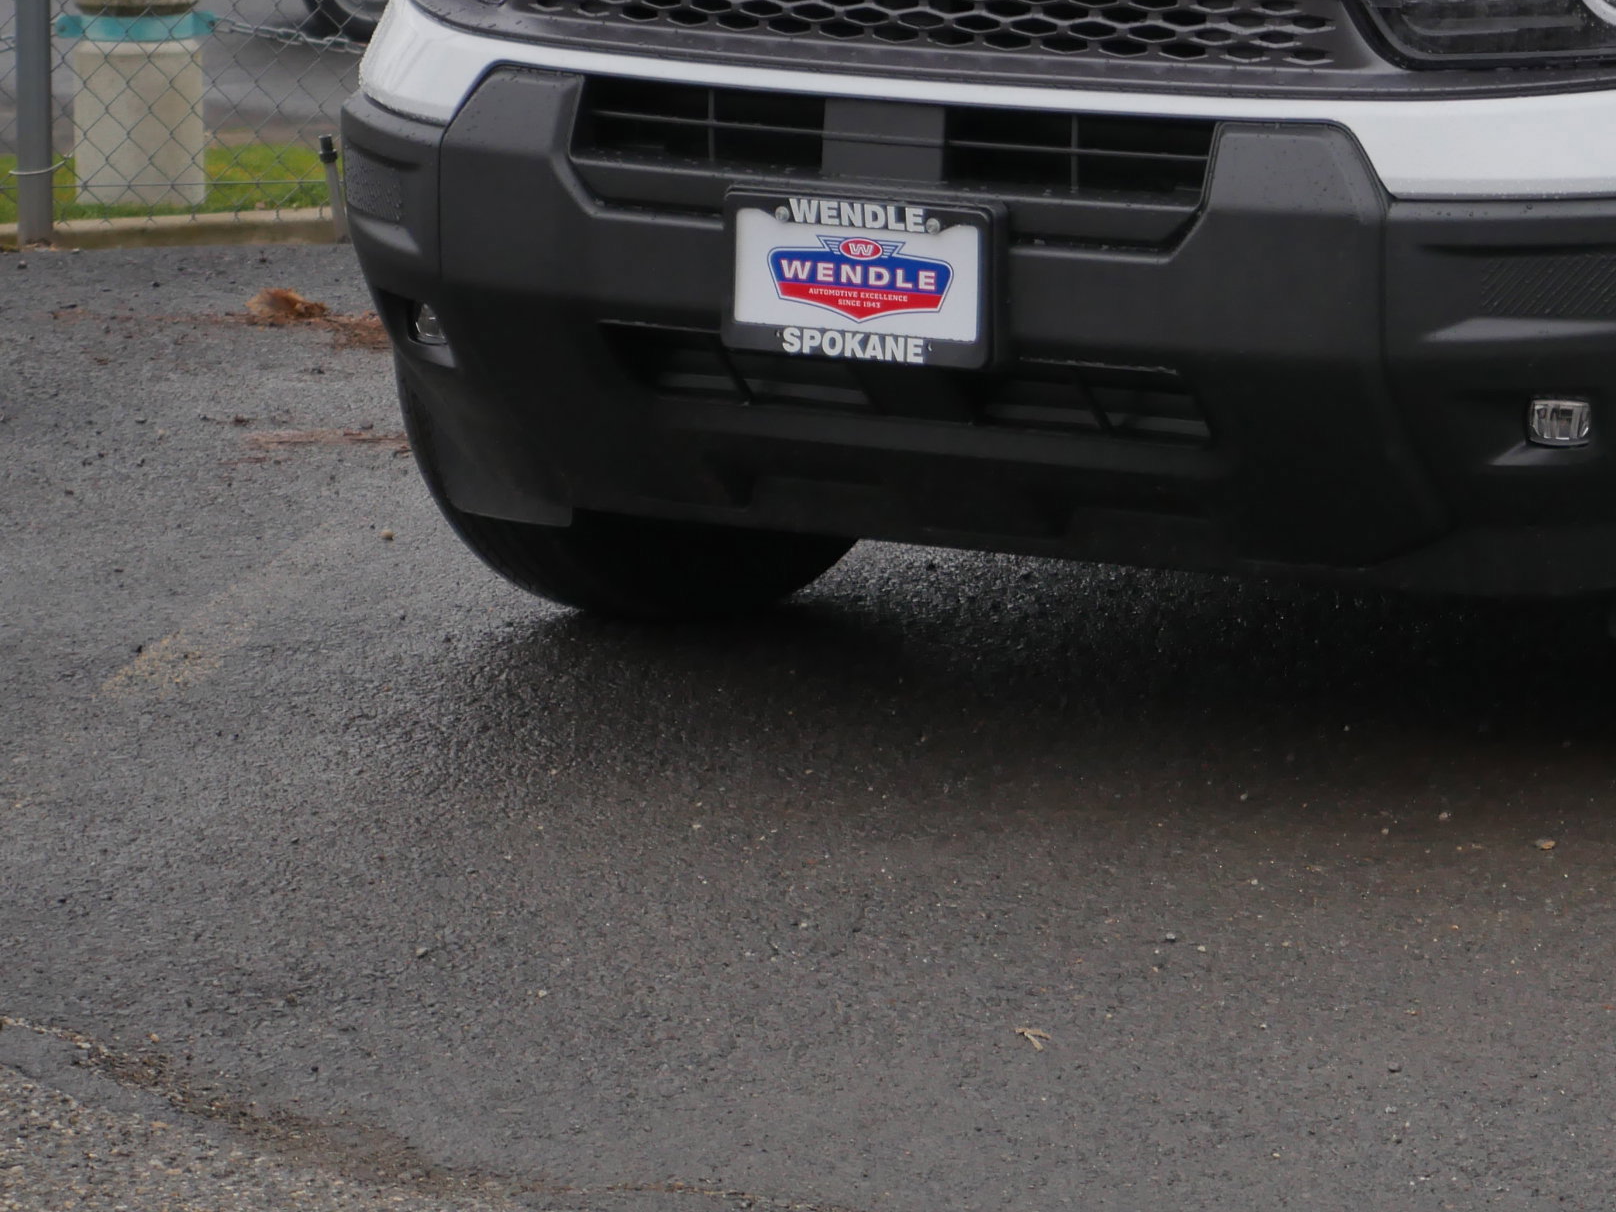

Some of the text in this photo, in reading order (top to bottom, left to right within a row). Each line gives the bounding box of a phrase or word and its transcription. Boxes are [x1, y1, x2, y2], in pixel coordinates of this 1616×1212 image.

[788, 197, 926, 233] WENDLE
[781, 259, 937, 291] WENDLE
[808, 287, 908, 302] AUTOMOTIVE EXCELLENCE
[838, 298, 881, 308] SINCE 1943
[782, 326, 924, 364] SPOKANE
